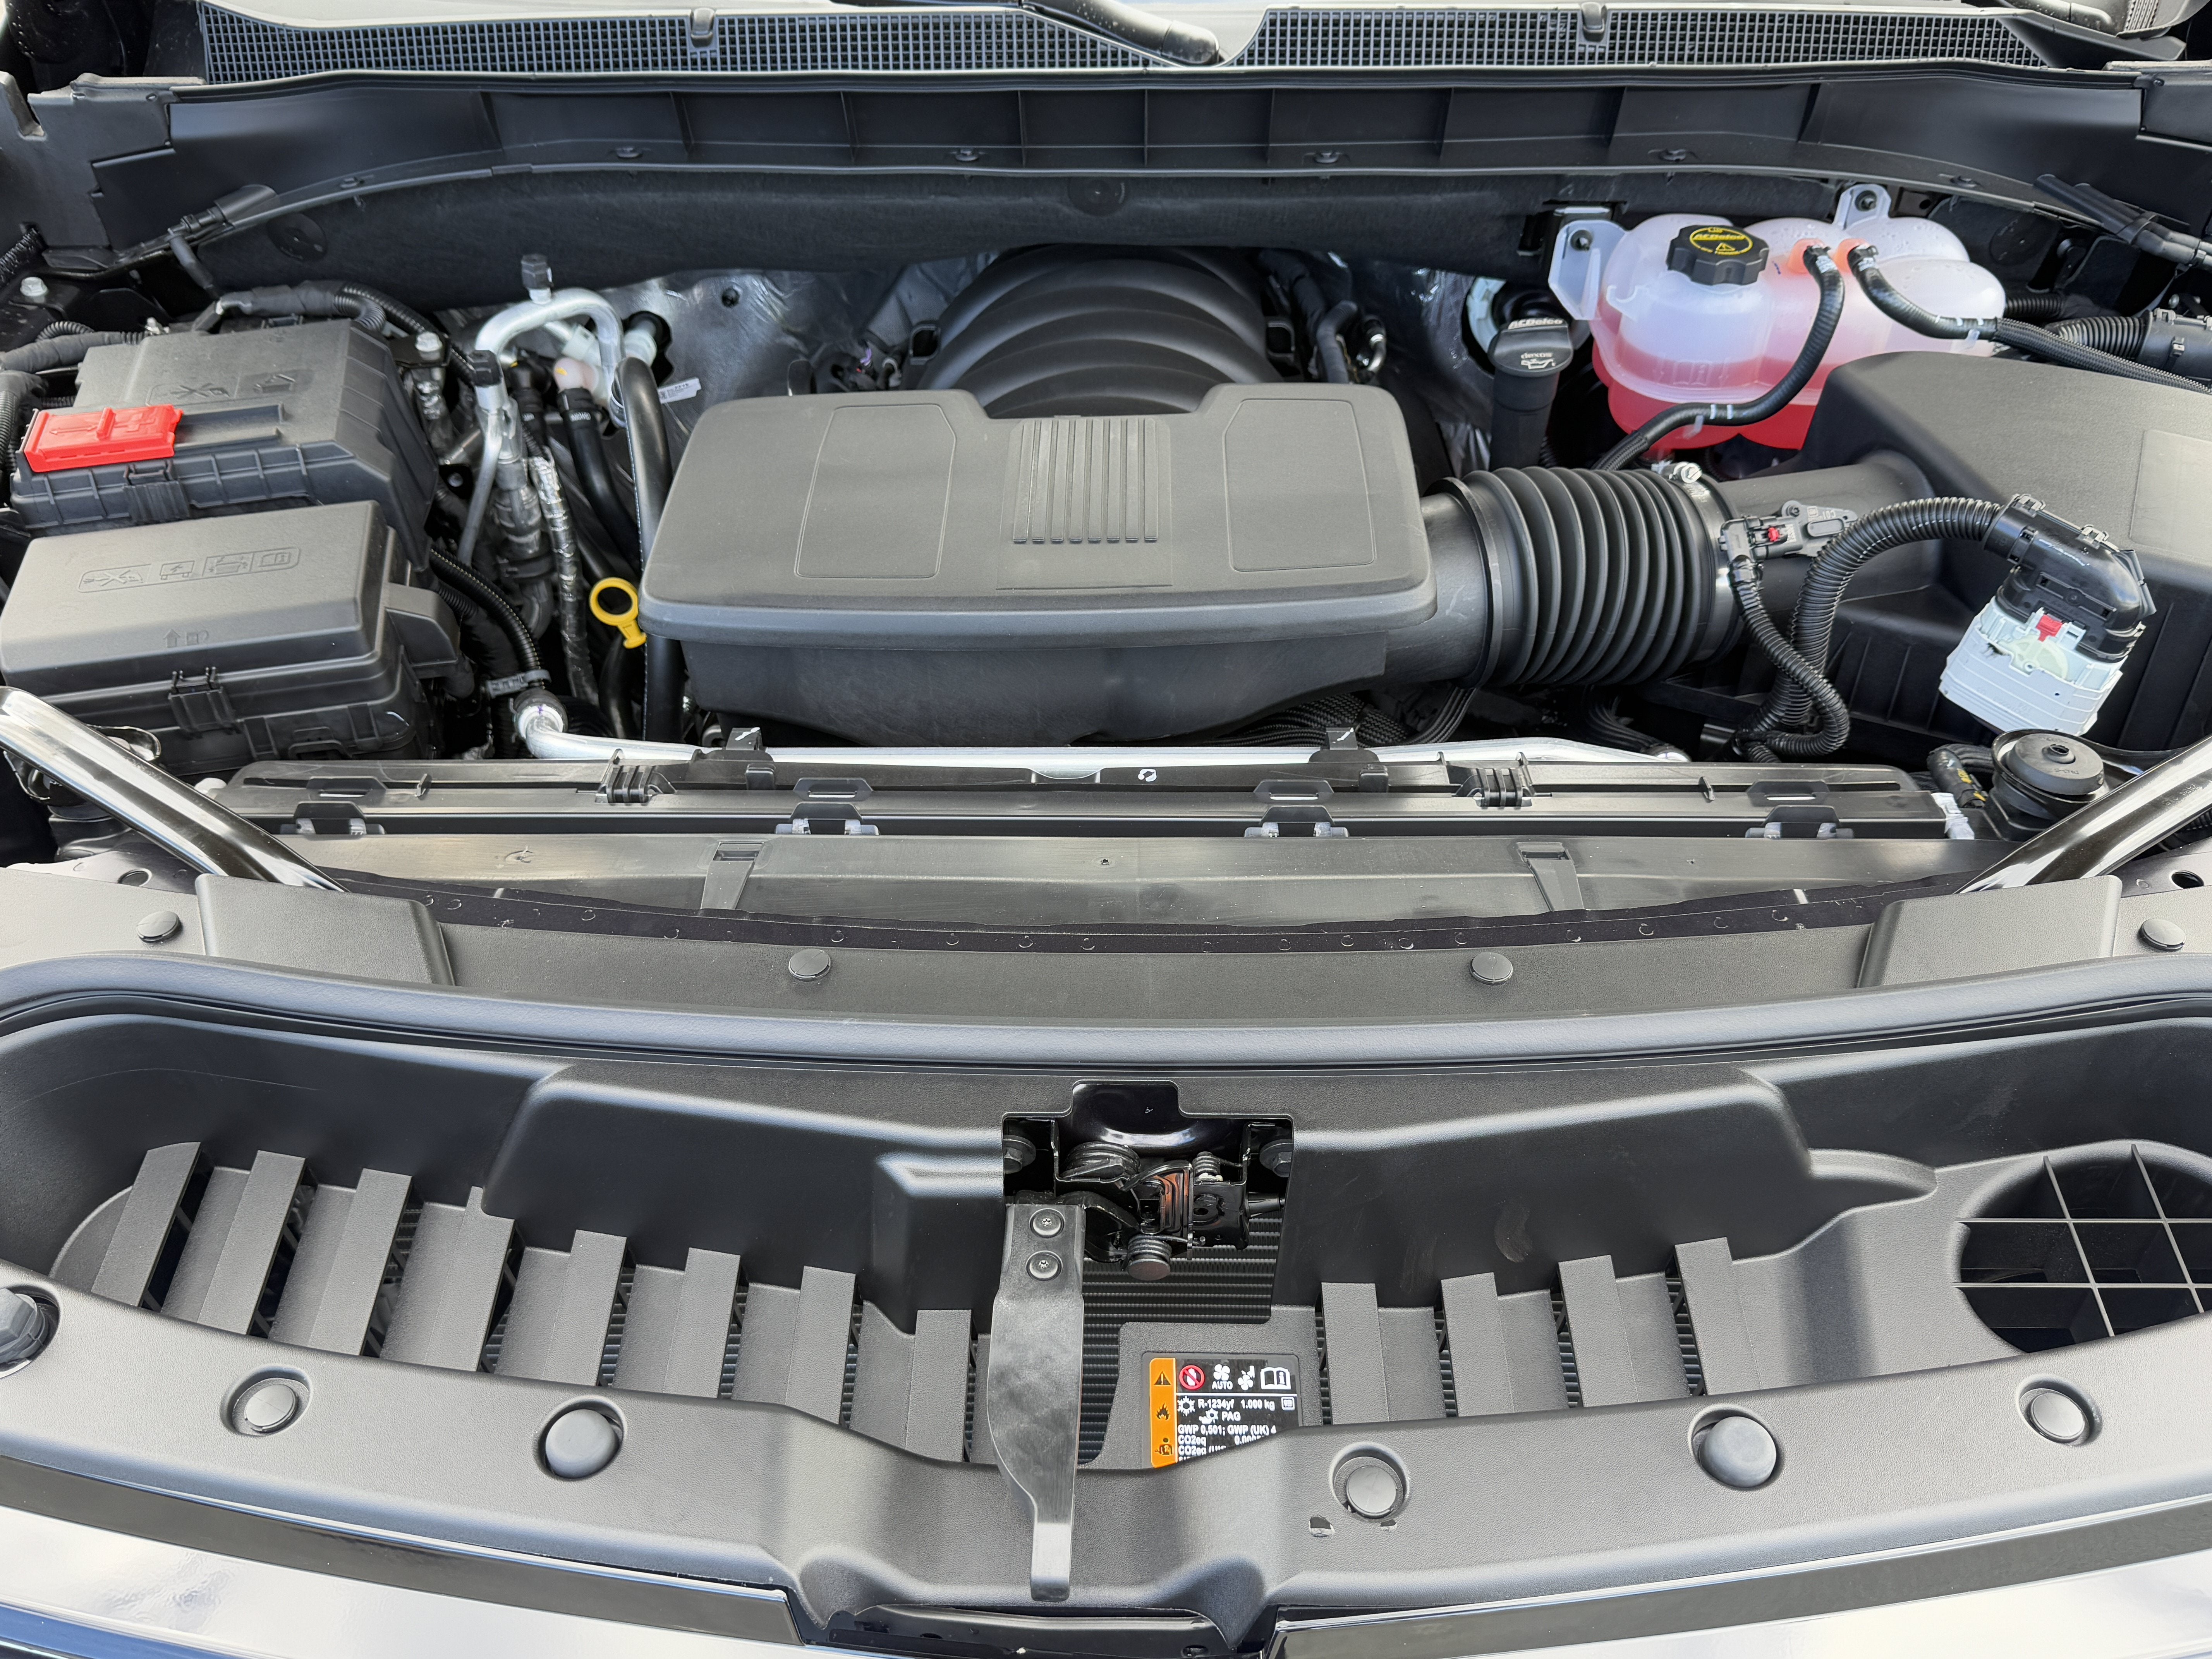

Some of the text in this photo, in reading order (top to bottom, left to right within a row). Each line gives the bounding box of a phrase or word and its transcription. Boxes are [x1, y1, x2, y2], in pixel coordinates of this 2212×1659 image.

[1508, 318, 1563, 329] ACDelco
[1212, 1381, 1233, 1389] AUTO
[1198, 1399, 1275, 1411] R-1234yf 1.000 kg
[1222, 1411, 1241, 1421] PAG
[1178, 1424, 1199, 1434] GWP
[1227, 1425, 1249, 1435] GWP
[1250, 1425, 1269, 1436] (UK)
[1178, 1435, 1207, 1446] CO2eq
